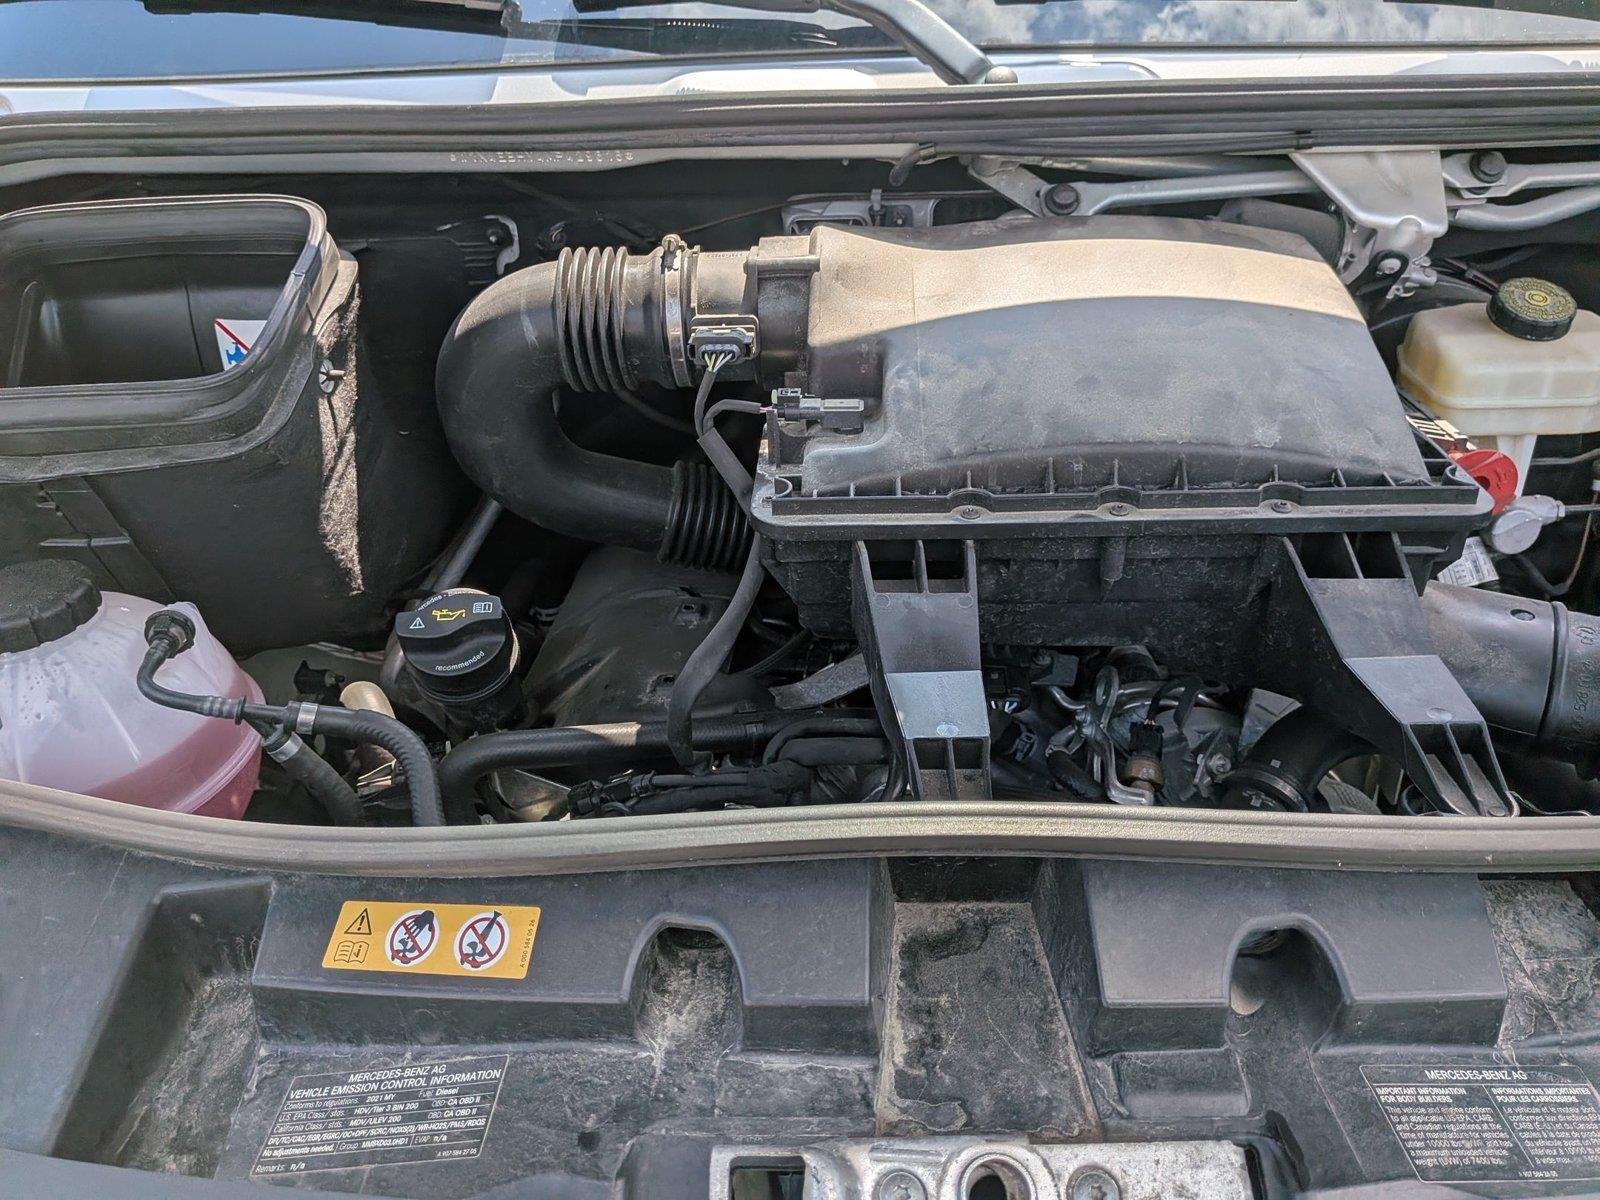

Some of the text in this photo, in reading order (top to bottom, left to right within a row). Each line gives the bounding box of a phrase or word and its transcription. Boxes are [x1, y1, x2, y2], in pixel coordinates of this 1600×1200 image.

[435, 650, 485, 671] recommended
[348, 1064, 447, 1083] MERCEDES-BENZ AG
[1424, 1070, 1528, 1080] MERCEDES-BENZ AG
[290, 1068, 502, 1099] VEHICLE EMISSION CONTROL INFORMATION
[435, 1087, 459, 1096] Diesel
[1375, 1087, 1466, 1095] IMPORTANT INFORMATION
[1491, 1087, 1591, 1095] INFORMATIONS IMPORTANTES
[366, 1093, 396, 1103] 2021 MY
[447, 1098, 457, 1106] CA
[459, 1096, 475, 1105] OBD
[1379, 1095, 1453, 1103] FOR BODY BUILDERS
[1496, 1095, 1579, 1103] POUR LES CARROSSIERS
[284, 1101, 314, 1111] Conforms
[392, 1103, 404, 1111] BIN
[405, 1102, 419, 1110] 200
[1403, 1106, 1426, 1114] vehicle
[1427, 1106, 1440, 1114] and
[1464, 1106, 1493, 1114] conform
[1503, 1106, 1512, 1114] Le
[293, 1112, 306, 1121] EPA
[443, 1110, 454, 1118] CA
[455, 1108, 471, 1117] OBD
[388, 1115, 401, 1123] 200
[1390, 1114, 1399, 1122] to
[1410, 1114, 1444, 1123] applicable
[1473, 1114, 1494, 1122] CARB
[1508, 1114, 1544, 1122] conformes
[274, 1124, 304, 1134] California
[1396, 1122, 1409, 1131] and
[1409, 1122, 1442, 1131] Canadian
[1443, 1122, 1482, 1132] regulations
[1489, 1123, 1502, 1131] the
[1513, 1122, 1535, 1130] CARB
[433, 1134, 447, 1143] n/a
[1399, 1131, 1417, 1139] time
[1425, 1131, 1468, 1139] manufacture
[1481, 1131, 1509, 1139] vehicles
[1404, 1140, 1425, 1148] under
[262, 1149, 272, 1157] No
[272, 1146, 310, 1157] adjustments
[290, 1162, 306, 1171] n/a
[1413, 1157, 1439, 1167] weight
[1463, 1157, 1471, 1165] of
